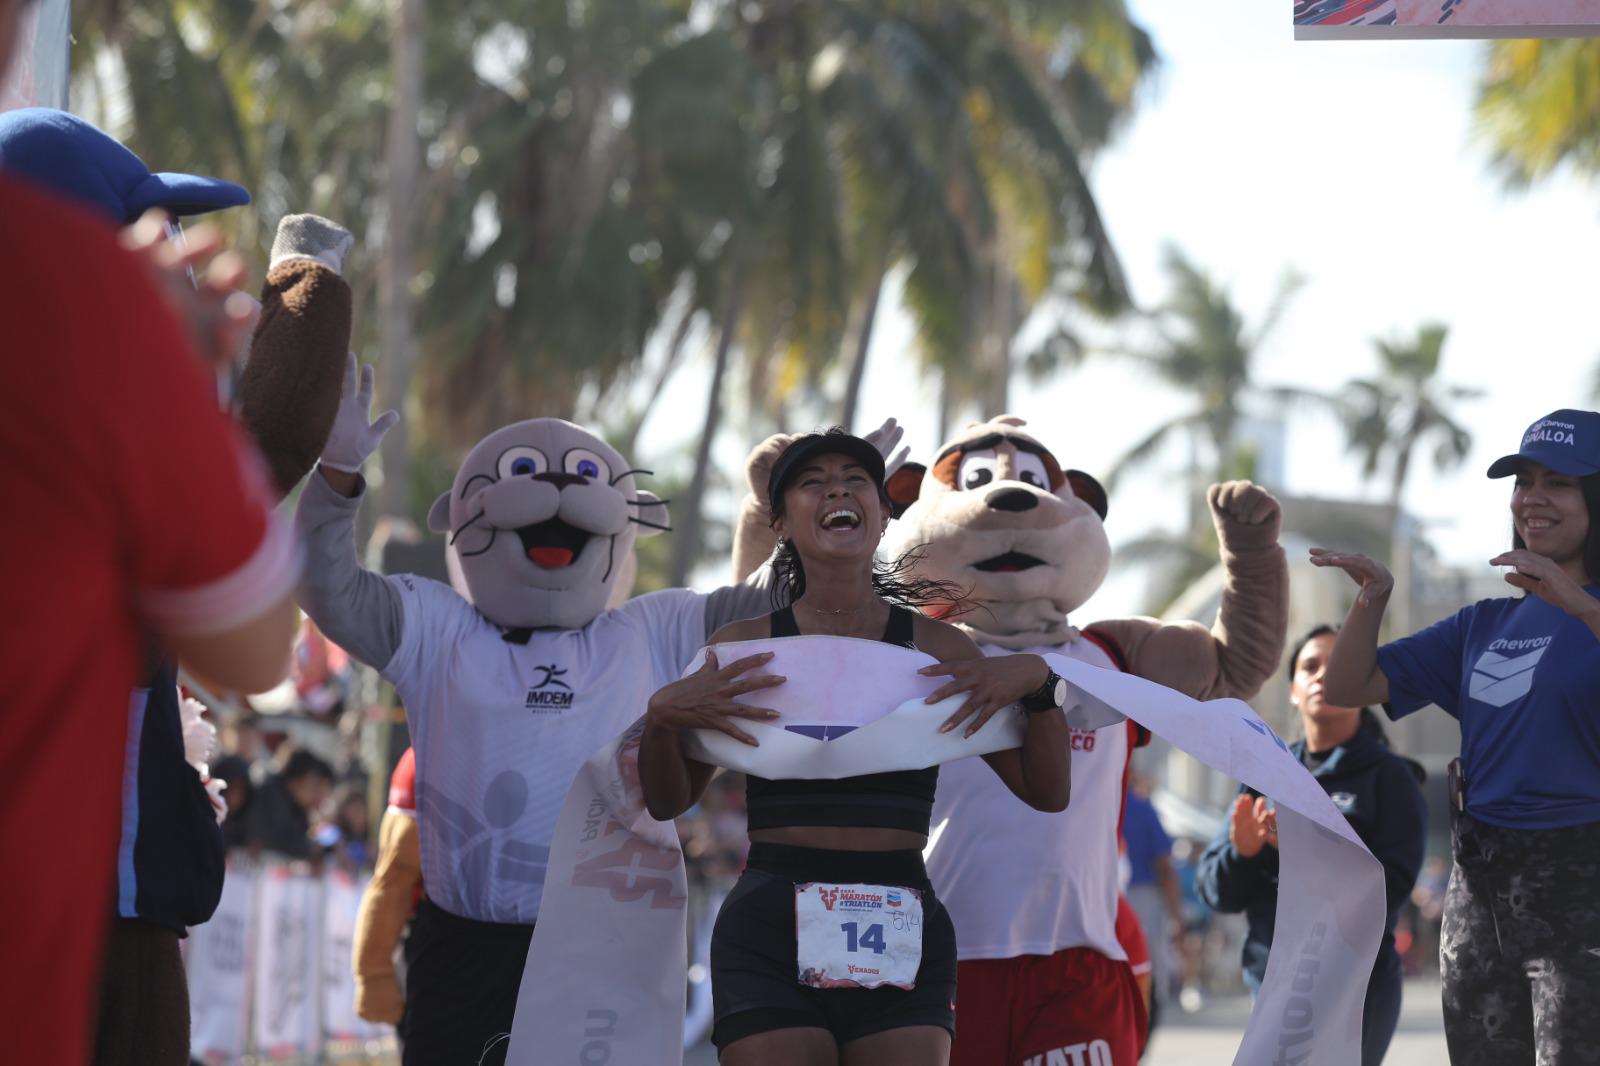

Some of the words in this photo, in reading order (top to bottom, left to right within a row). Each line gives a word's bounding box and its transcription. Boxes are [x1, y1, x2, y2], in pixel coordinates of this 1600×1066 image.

[1487, 636, 1553, 651] Chevron
[526, 691, 575, 705] IMDEM
[1071, 735, 1096, 752] CO
[841, 922, 886, 954] 14
